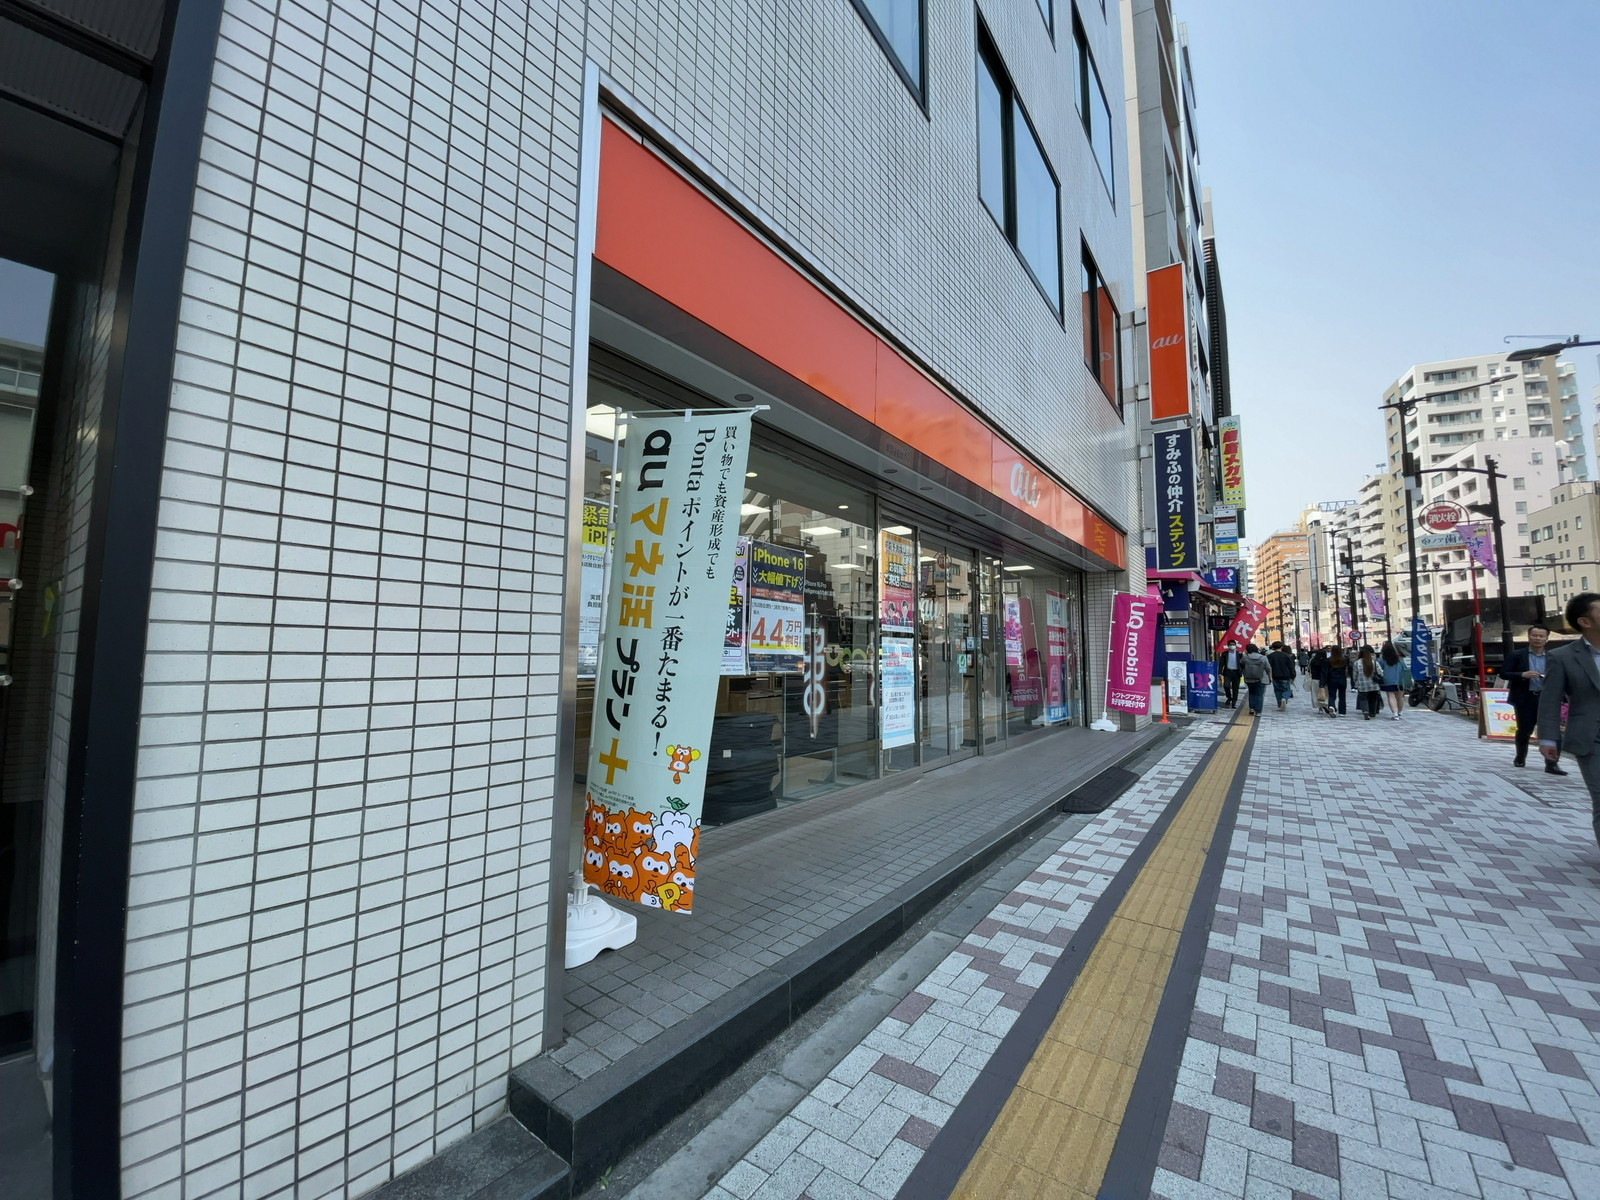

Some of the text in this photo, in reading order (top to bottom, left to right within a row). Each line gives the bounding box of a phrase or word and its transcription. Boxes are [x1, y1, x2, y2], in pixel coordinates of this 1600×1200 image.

[1152, 333, 1183, 350] au
[1010, 462, 1041, 509] au
[705, 425, 737, 580] 買い物でも資産形成でも
[1165, 433, 1186, 567] すみふの仲介ステップ
[1428, 511, 1457, 524] 消火栓
[753, 547, 790, 568] iPhone
[792, 556, 804, 571] 16
[758, 570, 799, 588] 大幅値下げ
[751, 616, 784, 648] 4.4
[785, 620, 802, 633] 万円
[1123, 601, 1146, 686] UQ mobile
[1111, 691, 1146, 701] トクトクプラン
[1111, 698, 1146, 709] 好評受付中
